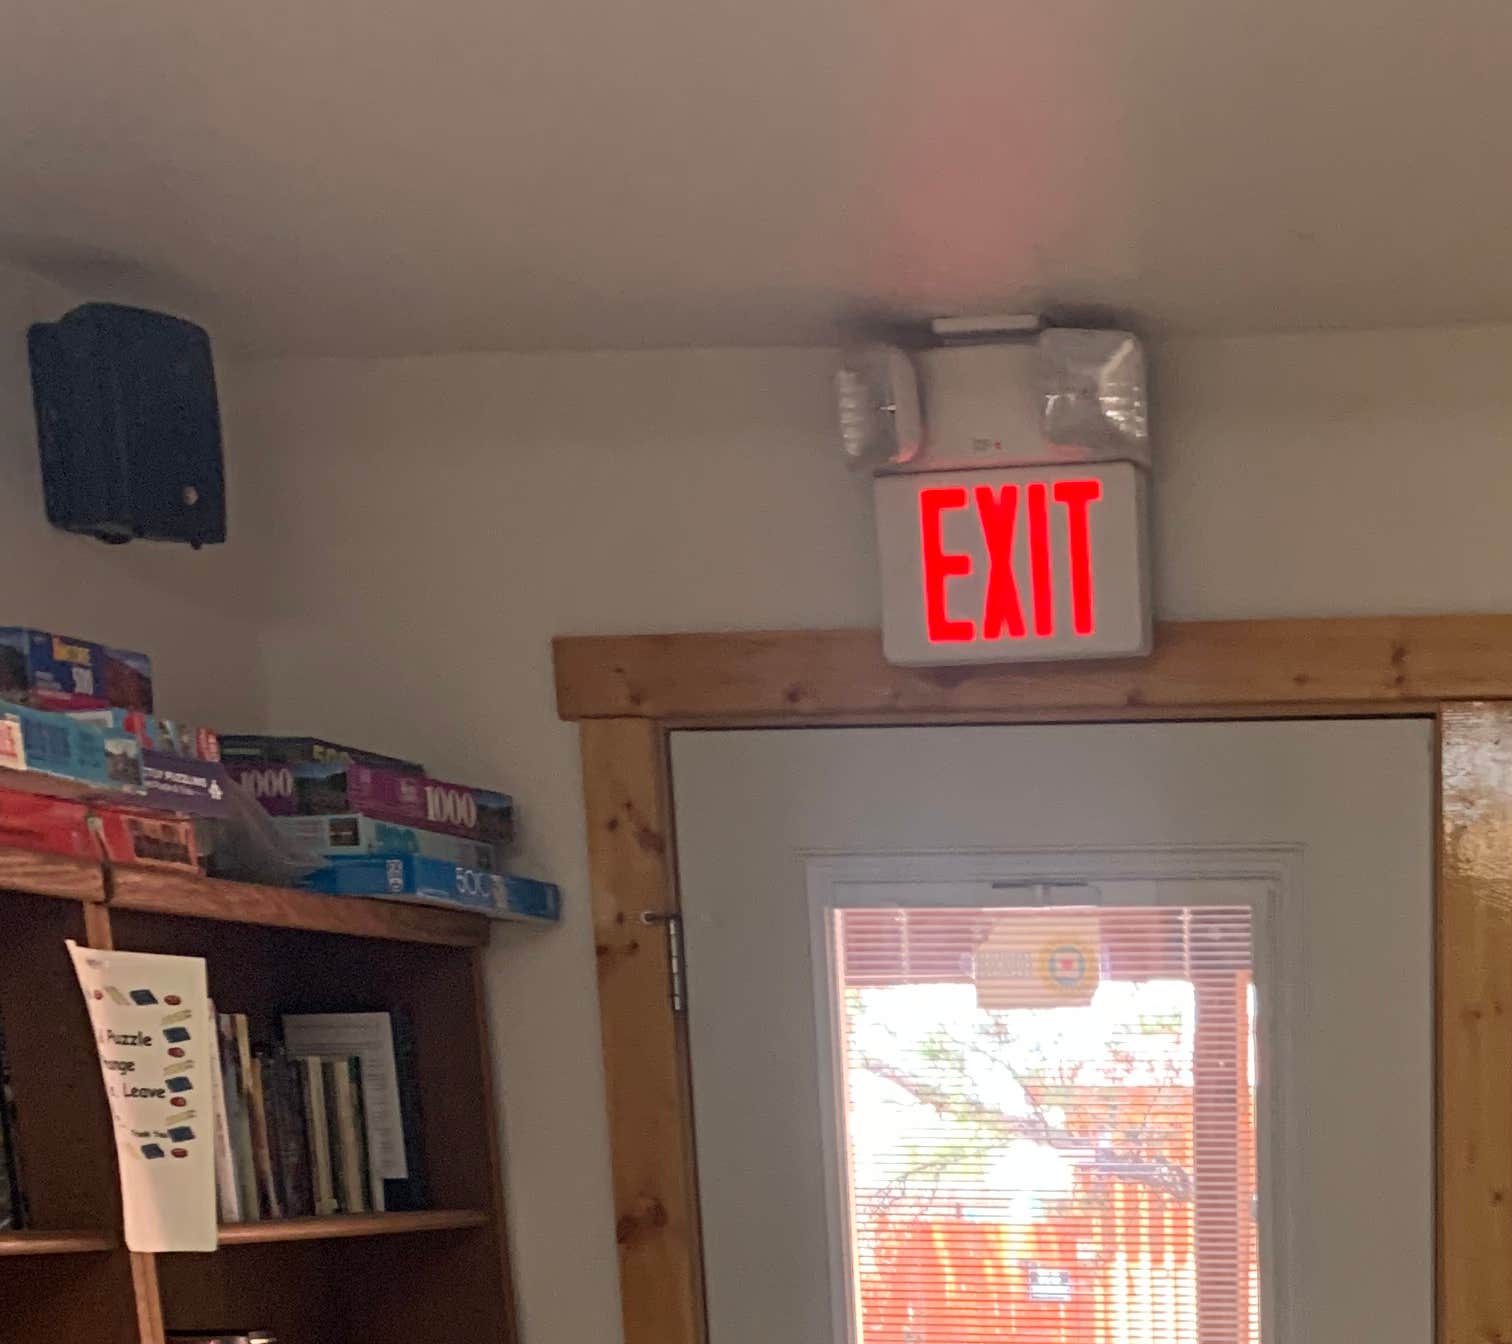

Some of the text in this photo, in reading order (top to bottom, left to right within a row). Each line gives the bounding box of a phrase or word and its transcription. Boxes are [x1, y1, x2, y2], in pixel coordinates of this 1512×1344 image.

[918, 479, 1102, 644] EXIT
[424, 785, 478, 828] 1000
[123, 1083, 166, 1100] Leave
